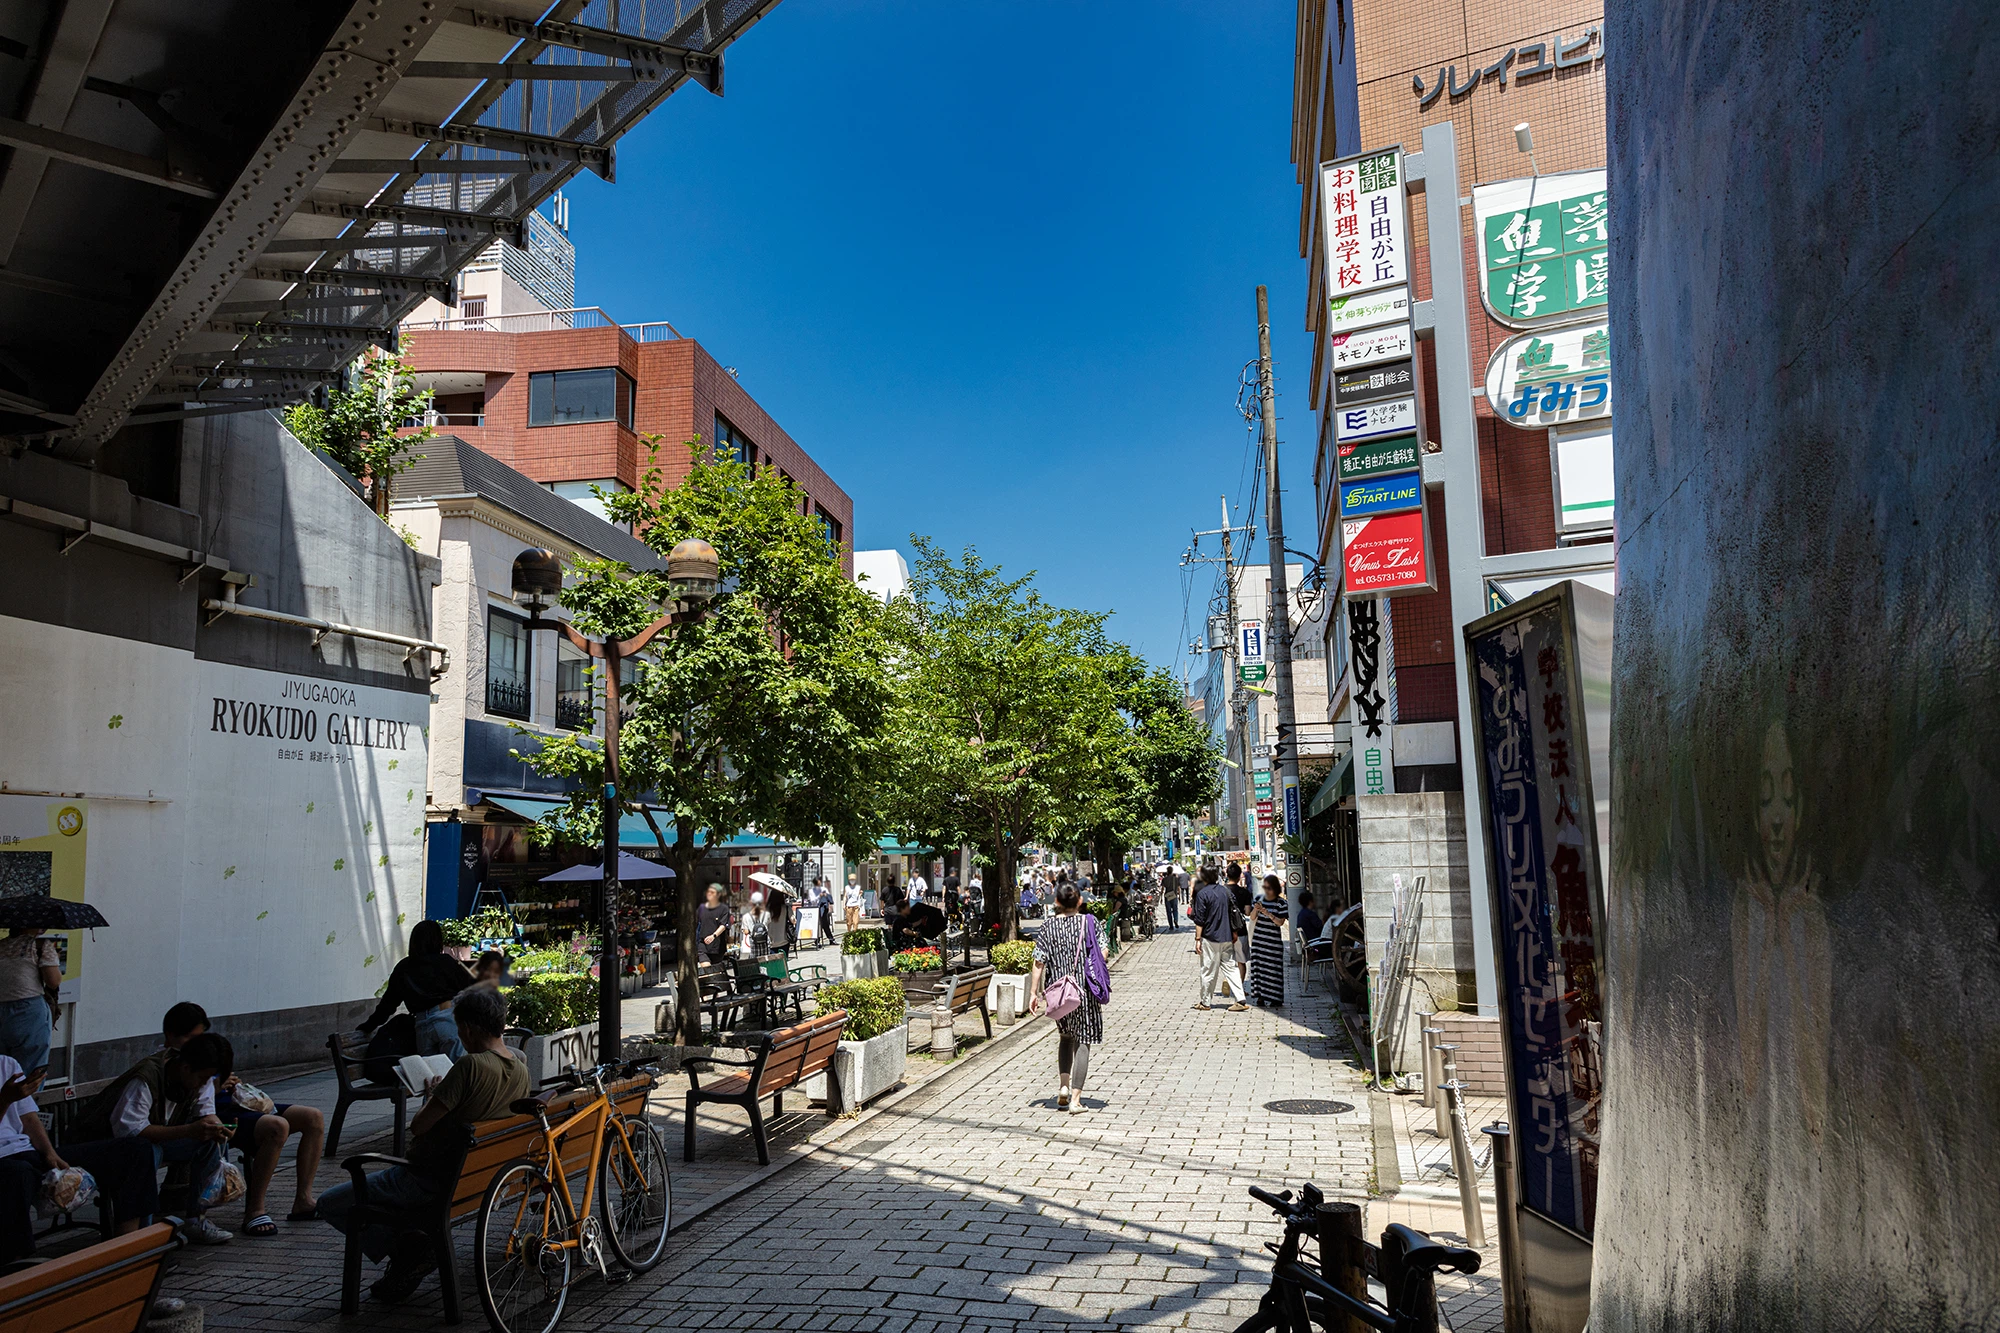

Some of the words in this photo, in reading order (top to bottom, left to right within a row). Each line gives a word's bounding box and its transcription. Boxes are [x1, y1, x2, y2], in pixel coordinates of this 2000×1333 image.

[1413, 23, 1604, 105] ソレイユビ
[1331, 168, 1363, 289] お料理学校
[1370, 195, 1395, 283] 自由が丘
[1333, 301, 1344, 309] 4F
[1334, 336, 1347, 345] 4F
[1345, 339, 1375, 349] KIMONO
[1378, 335, 1398, 343] MODE
[1338, 340, 1407, 362] キモノモード
[1508, 373, 1612, 418] よみう
[1370, 403, 1407, 417] 大学受験
[1371, 415, 1396, 426] ナビオ
[1340, 446, 1352, 455] 2F
[1345, 488, 1390, 508] START
[1391, 488, 1417, 501] LINE
[1345, 522, 1361, 535] 2F
[1349, 552, 1381, 573] Venus
[1383, 547, 1421, 568] Lash
[1247, 630, 1258, 655] KEN
[282, 680, 357, 707] JIYUGAOKA
[210, 697, 317, 743] RYOKUDO
[327, 713, 410, 750] GALLERY
[277, 748, 304, 761] 自由が丘
[310, 751, 353, 764] 緑道ギャラリー
[0, 835, 21, 846] 周年
